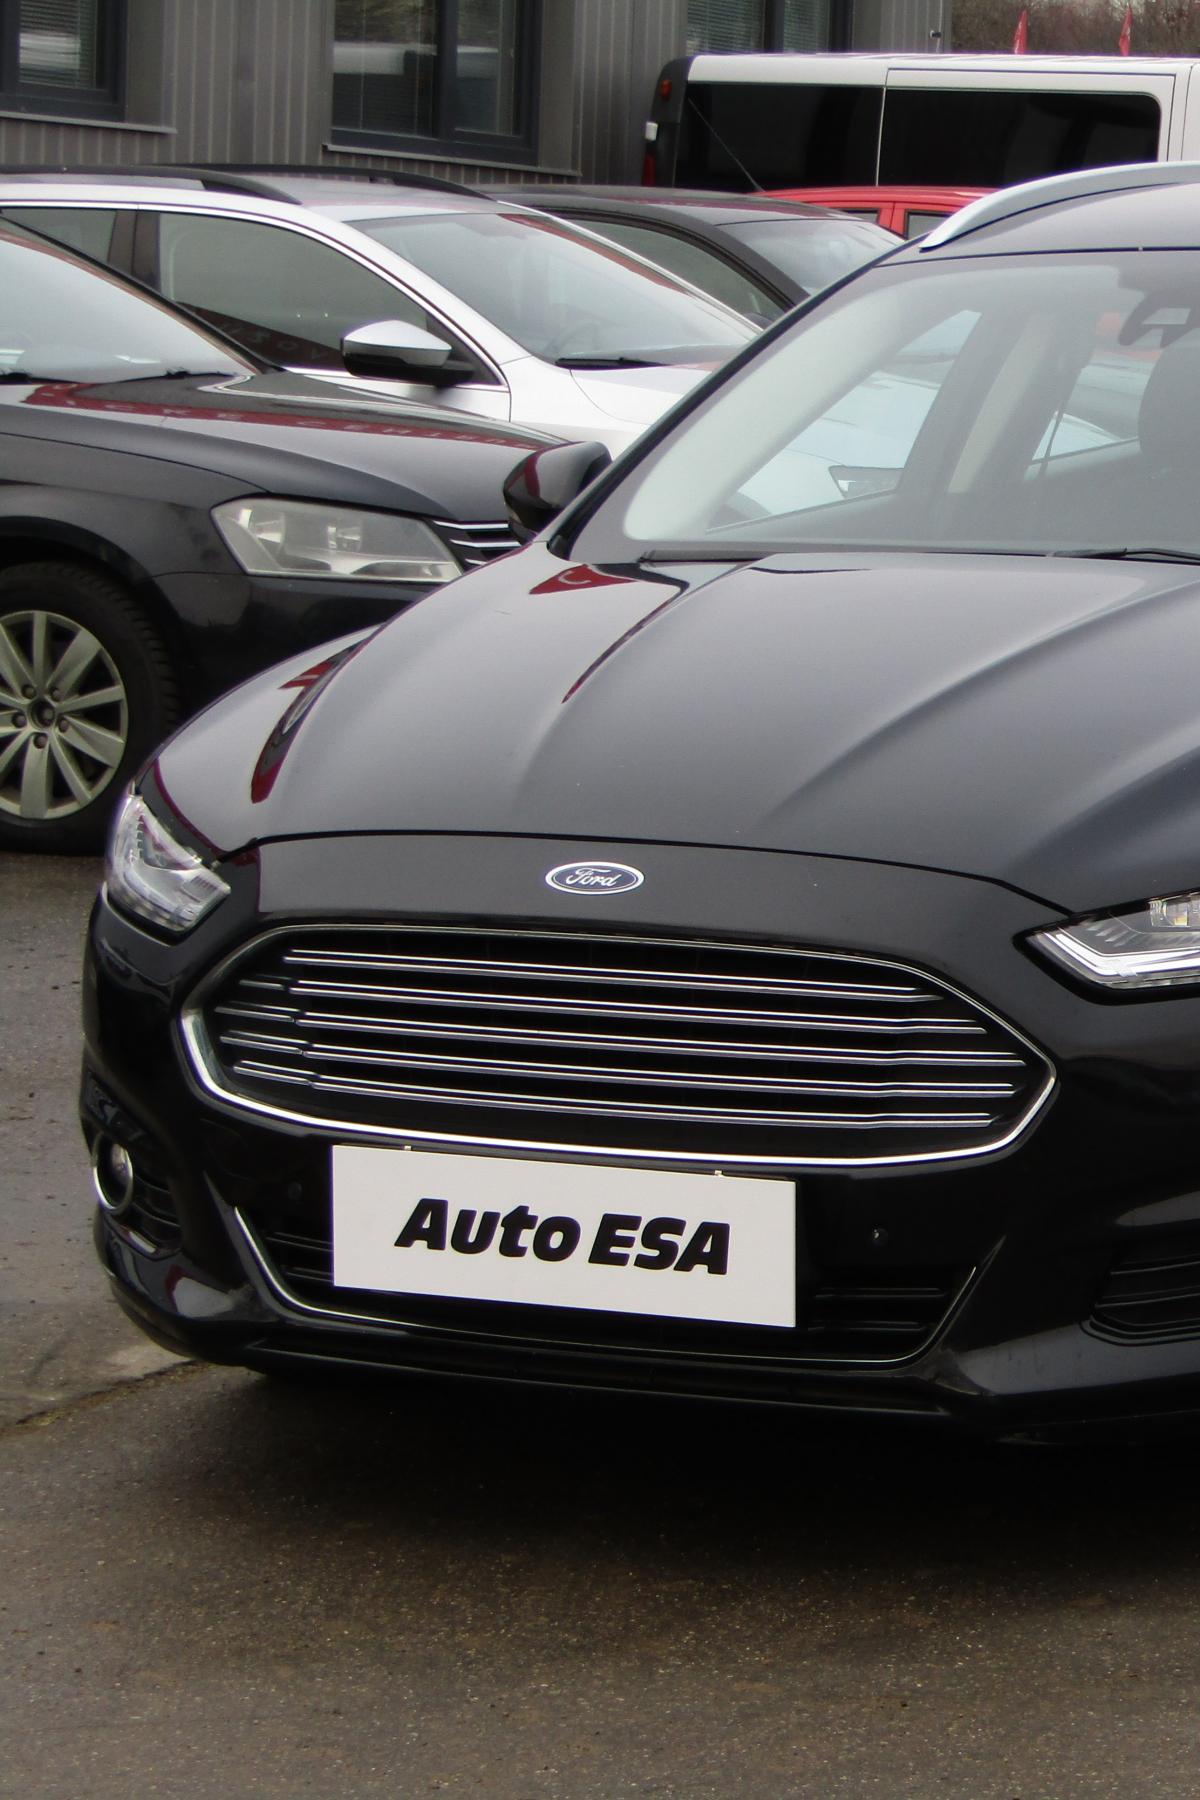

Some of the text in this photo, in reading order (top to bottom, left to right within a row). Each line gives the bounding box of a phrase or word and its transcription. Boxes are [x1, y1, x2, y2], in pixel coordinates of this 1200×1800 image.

[565, 867, 621, 887] Ford
[394, 1197, 731, 1276] Auto ESA
